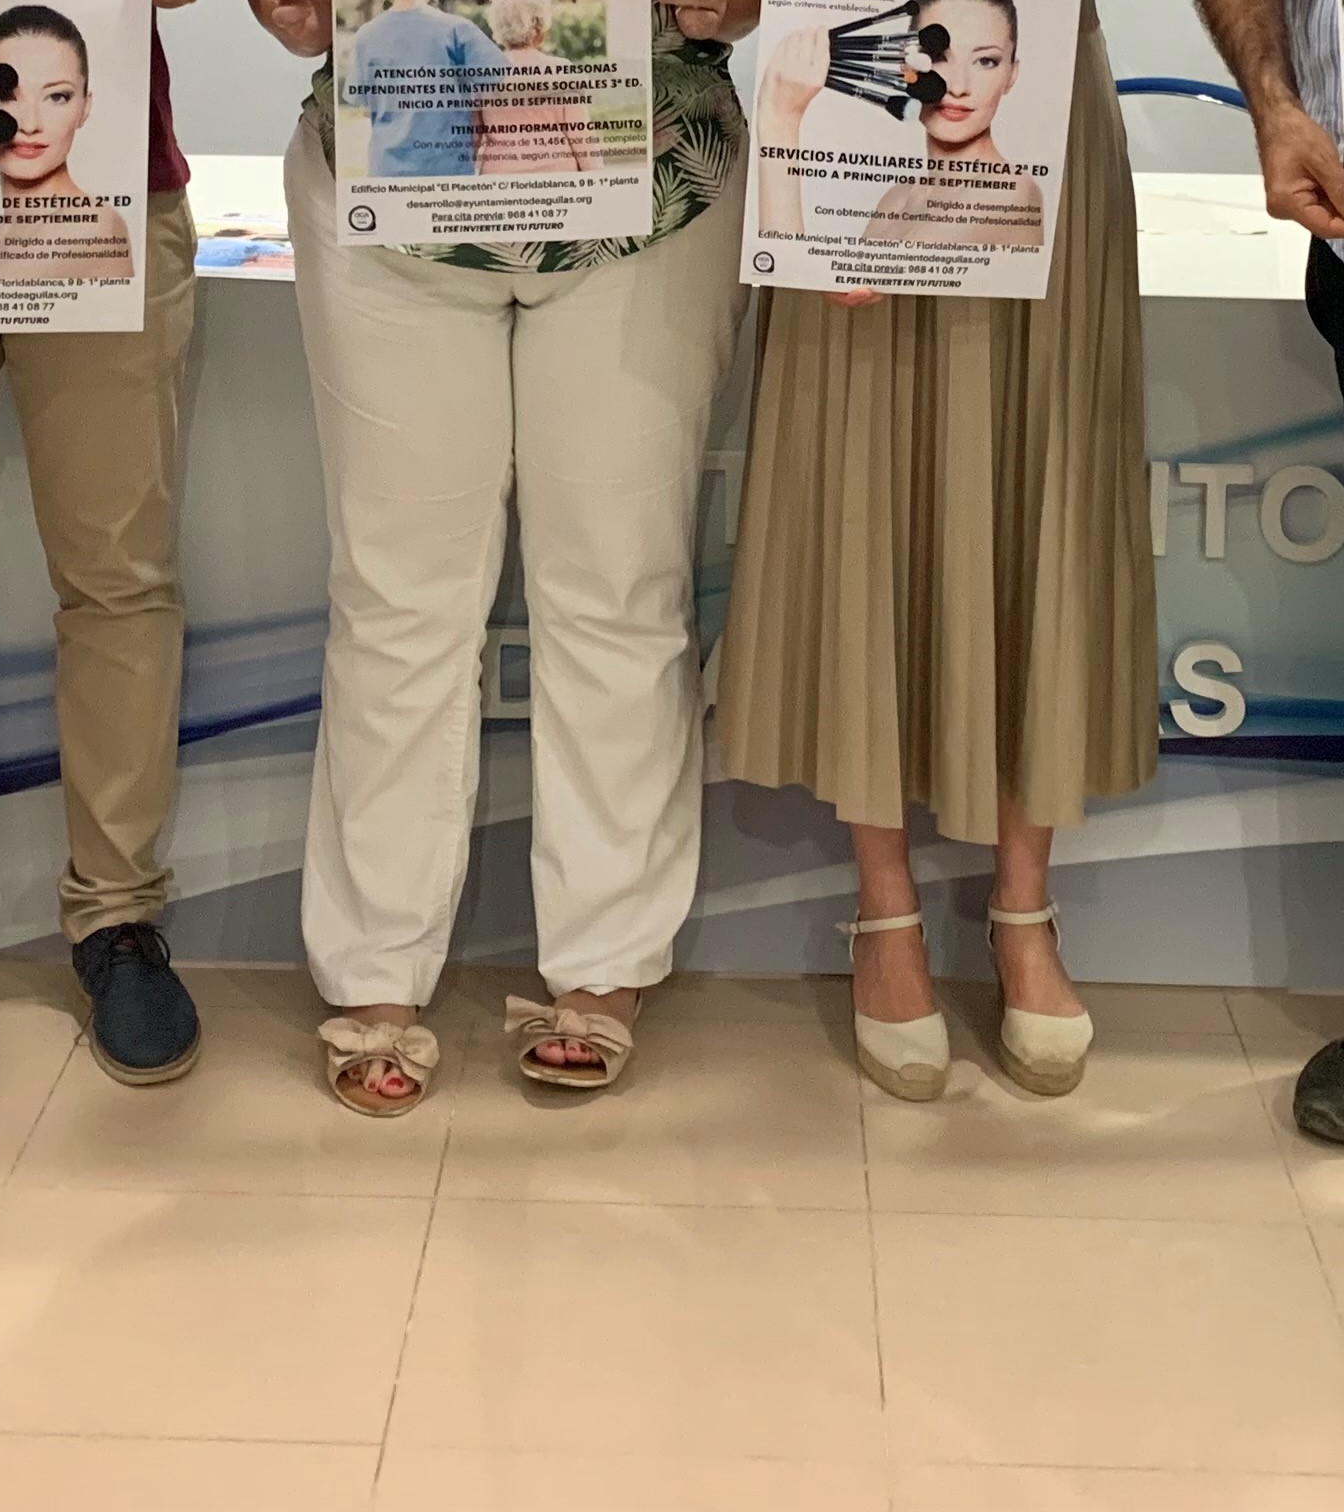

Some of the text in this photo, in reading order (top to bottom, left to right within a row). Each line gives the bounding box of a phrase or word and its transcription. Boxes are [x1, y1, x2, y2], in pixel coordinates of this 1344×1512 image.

[373, 59, 617, 78] ATENCIÓN SOCIOSANITARIA A PERSONAS
[348, 84, 436, 94] DEPENDIENTES
[439, 84, 455, 93] EN
[456, 80, 549, 93] INSTITUCIONES
[551, 79, 607, 90] SOCIALES
[398, 95, 592, 110] INICIO A PRINCIPIOS DE SEPTIEMBRE
[759, 146, 834, 162] SERVICIOS
[837, 152, 923, 169] AUXILIARES
[926, 153, 944, 170] DE
[948, 158, 1011, 174] ESTÉTICA
[1031, 164, 1049, 176] ED
[1, 196, 20, 209] DE
[24, 194, 91, 208] ESTÉTICA
[113, 195, 131, 206] ED
